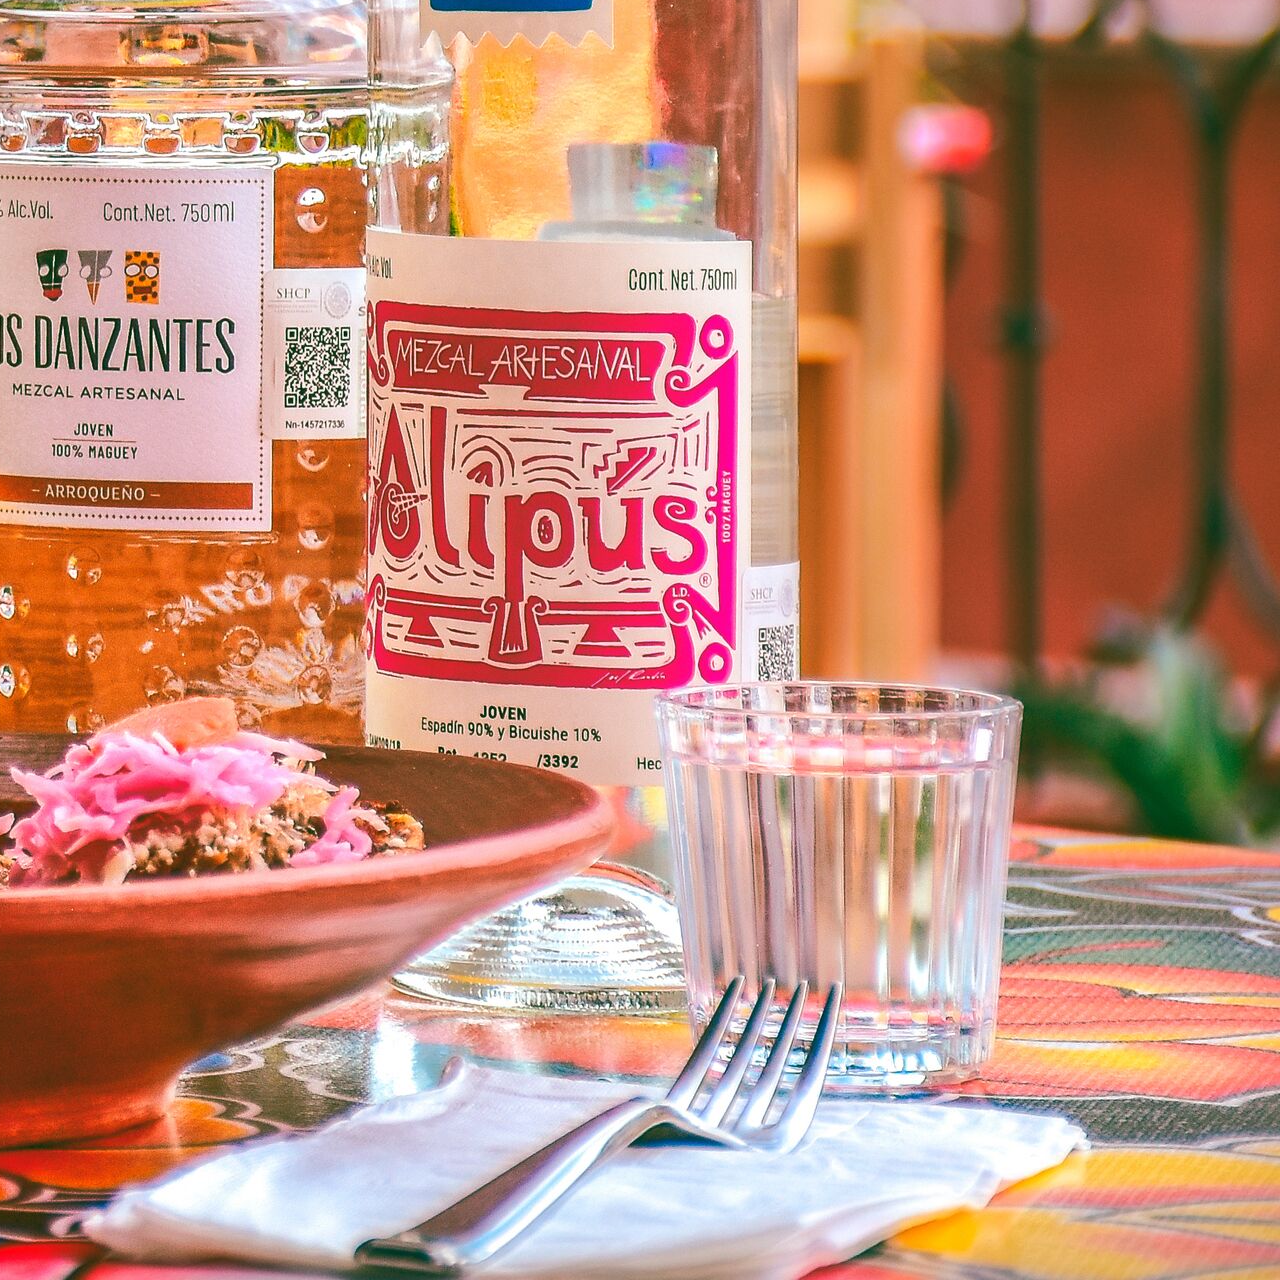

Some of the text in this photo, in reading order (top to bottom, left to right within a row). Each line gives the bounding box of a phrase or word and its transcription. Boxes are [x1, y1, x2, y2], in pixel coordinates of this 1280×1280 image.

[180, 201, 235, 223] 750ml
[628, 268, 737, 291] Cont. Net. 750ml
[276, 287, 311, 299] SHCP
[34, 314, 236, 374] DANZANTES
[394, 336, 652, 383] MEZCAL ARTESANAL
[12, 382, 186, 401] MEZCAL ARTESANAL
[74, 423, 114, 437] JOVEN
[51, 443, 138, 460] 100% MAGUEY
[45, 484, 145, 503] ARROQUEÑO
[672, 587, 690, 598] L.D.
[750, 586, 774, 600] SHCP
[480, 705, 527, 721] JOVEN
[421, 716, 602, 742] Espadín 90% y Bicuishe 10%
[536, 754, 580, 769] /3392
